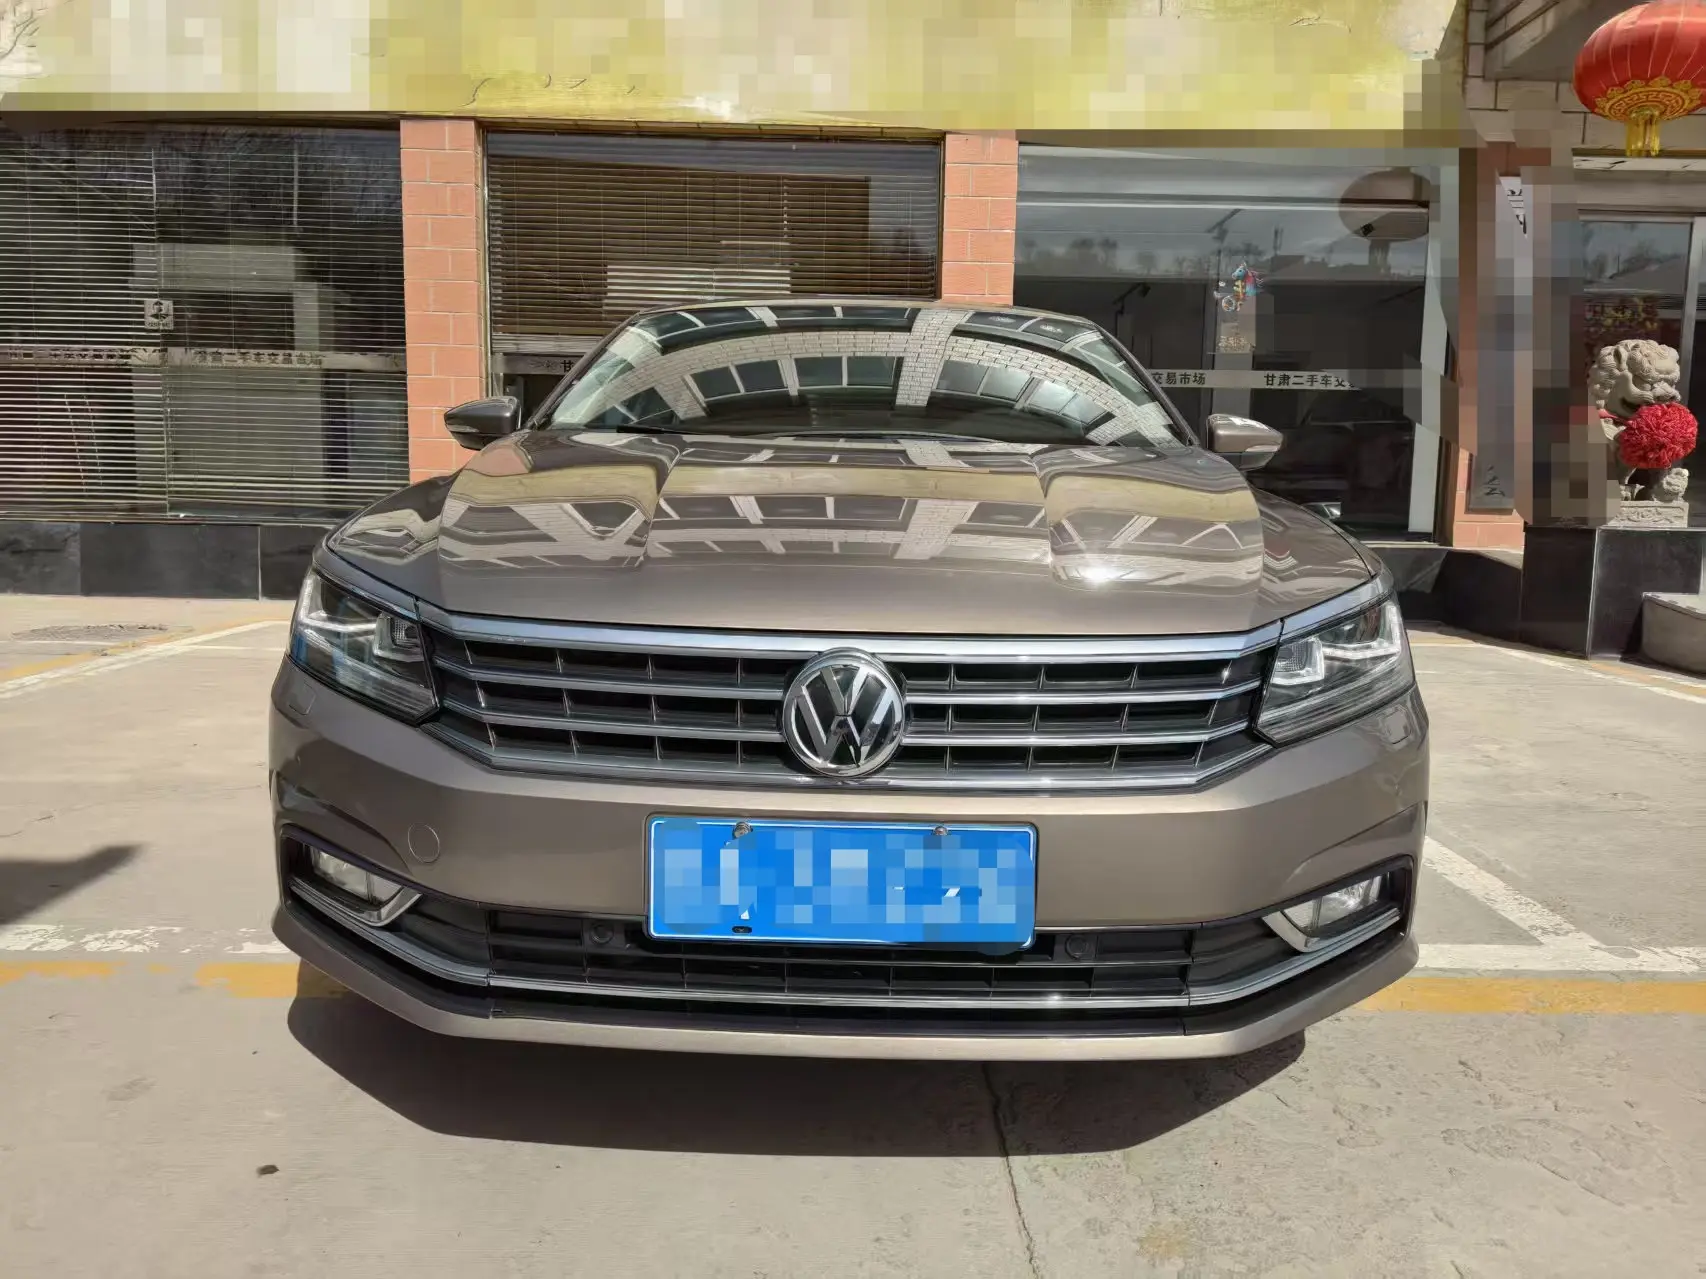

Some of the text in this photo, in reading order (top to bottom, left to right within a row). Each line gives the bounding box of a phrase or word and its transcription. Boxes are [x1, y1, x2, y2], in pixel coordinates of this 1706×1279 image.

[1151, 371, 1206, 386] 交易市场
[1263, 373, 1353, 388] 甘肃二手车交
